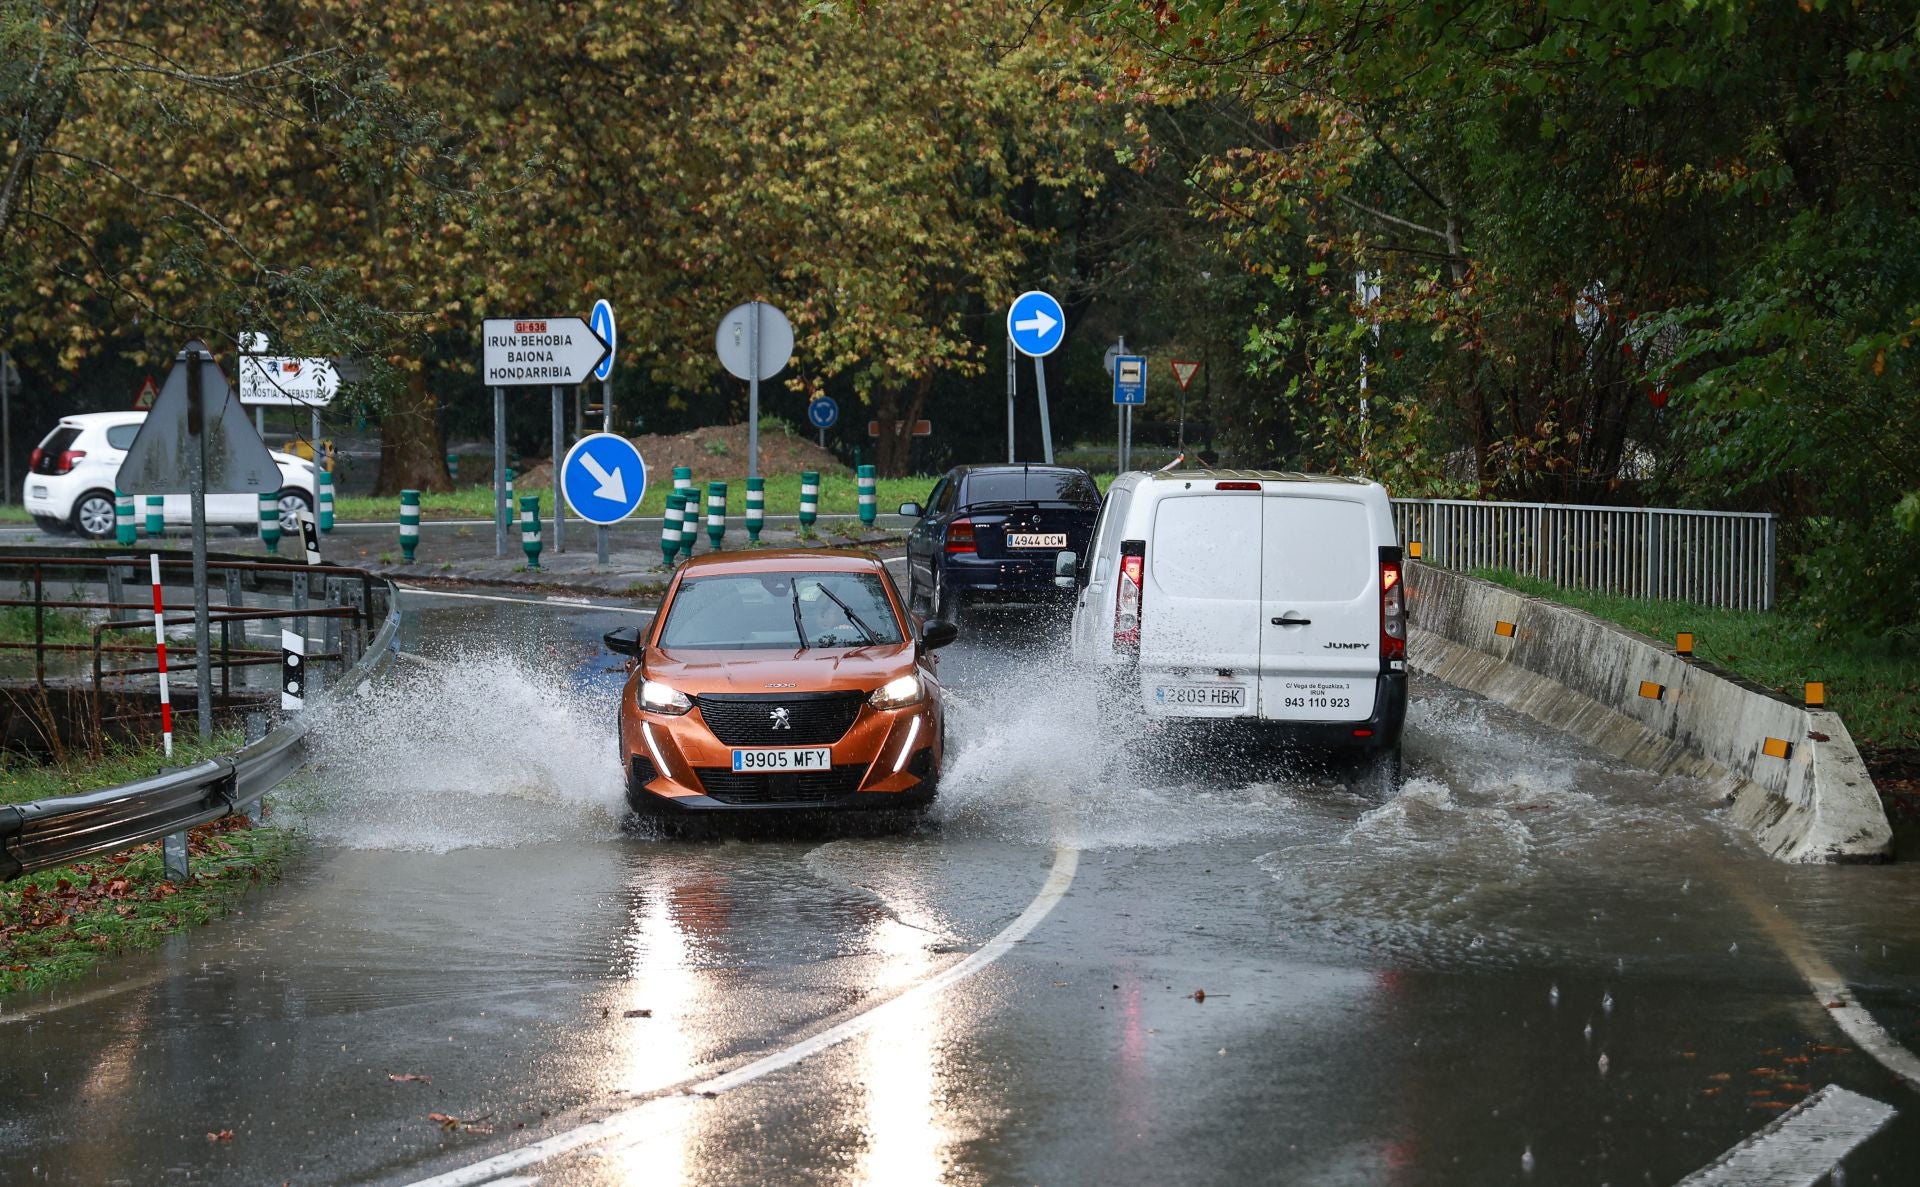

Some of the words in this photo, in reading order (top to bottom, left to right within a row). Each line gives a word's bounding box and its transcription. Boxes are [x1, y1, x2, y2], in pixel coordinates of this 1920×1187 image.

[515, 322, 546, 332] GI-636
[507, 351, 554, 363] BAIONA
[489, 366, 572, 379] HONDARRIBIA
[1014, 535, 1041, 546] 4944
[1044, 535, 1064, 546] CCM
[1323, 642, 1370, 650] JUMPY
[1211, 689, 1240, 704] HBK
[1284, 697, 1305, 707] 943
[1308, 698, 1327, 707] 110
[1330, 698, 1350, 708] 923
[745, 752, 788, 768] 9905
[794, 750, 826, 767] MFY
